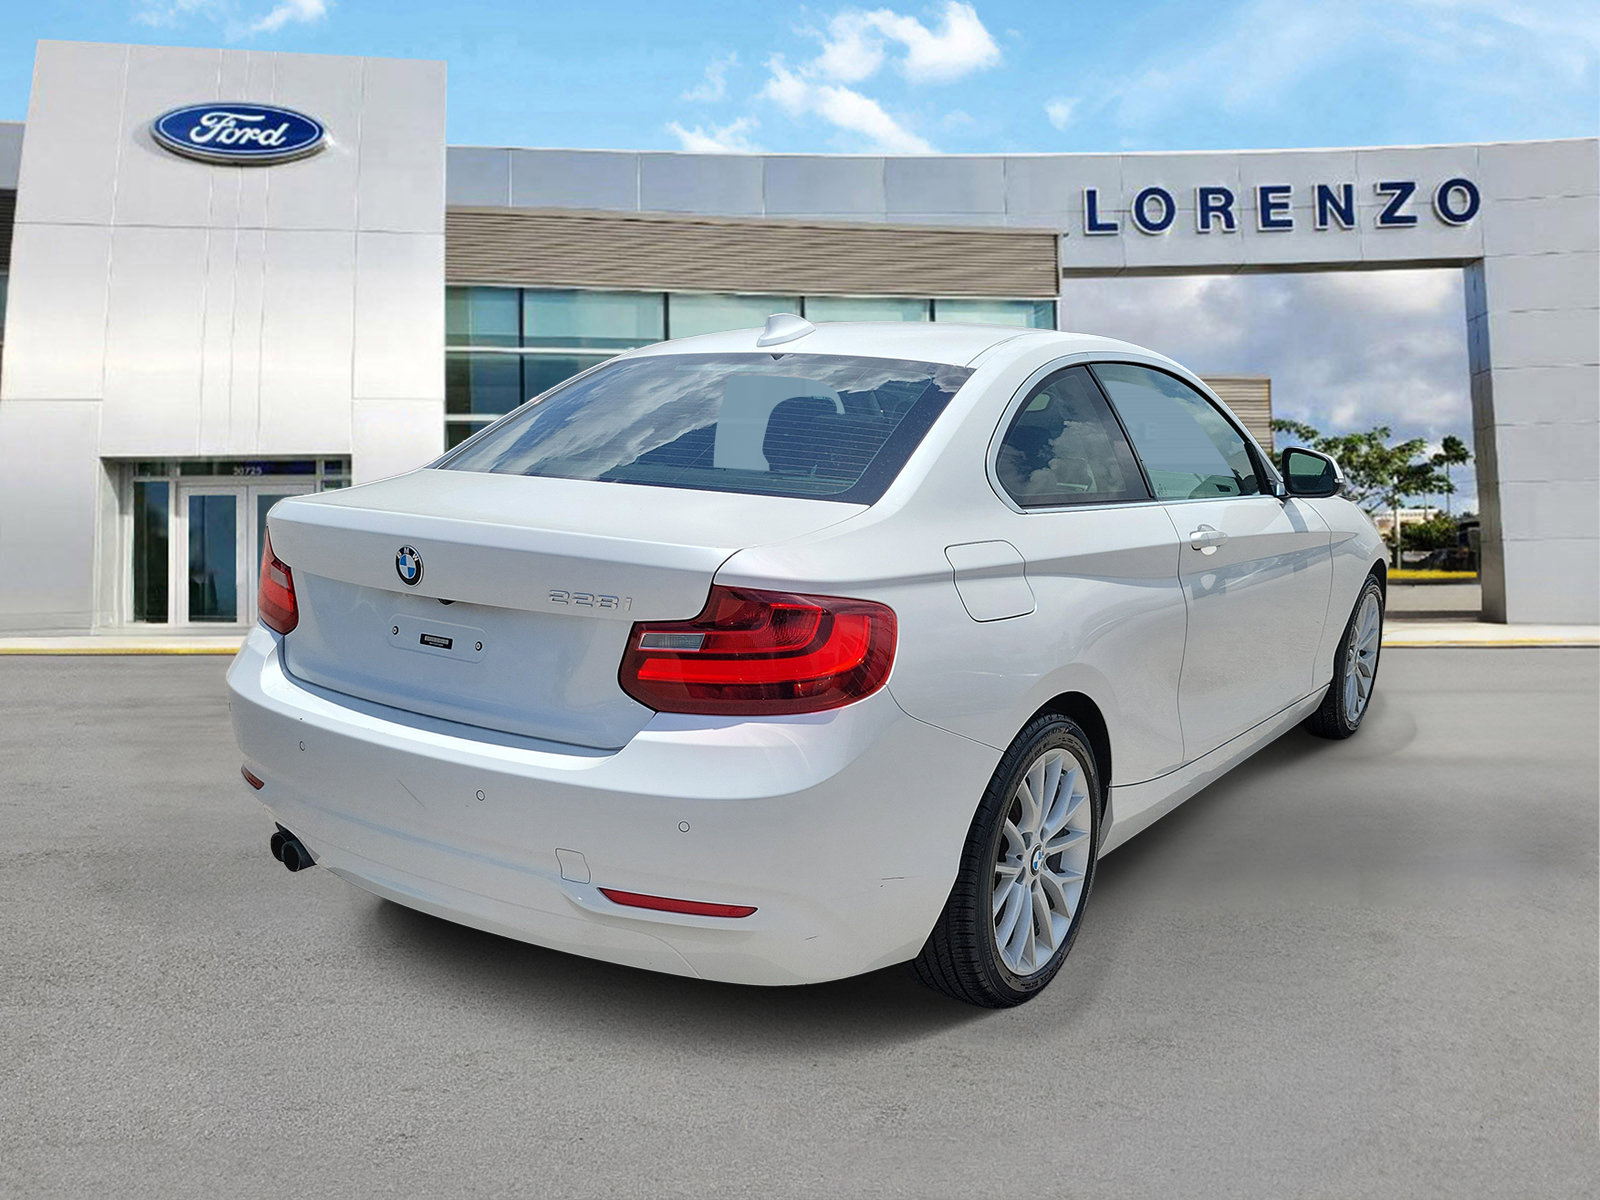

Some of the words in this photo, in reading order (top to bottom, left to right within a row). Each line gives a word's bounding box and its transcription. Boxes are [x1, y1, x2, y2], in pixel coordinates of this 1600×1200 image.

[190, 111, 289, 146] Ford
[1083, 178, 1482, 236] LORENZO
[548, 589, 633, 612] 228i
